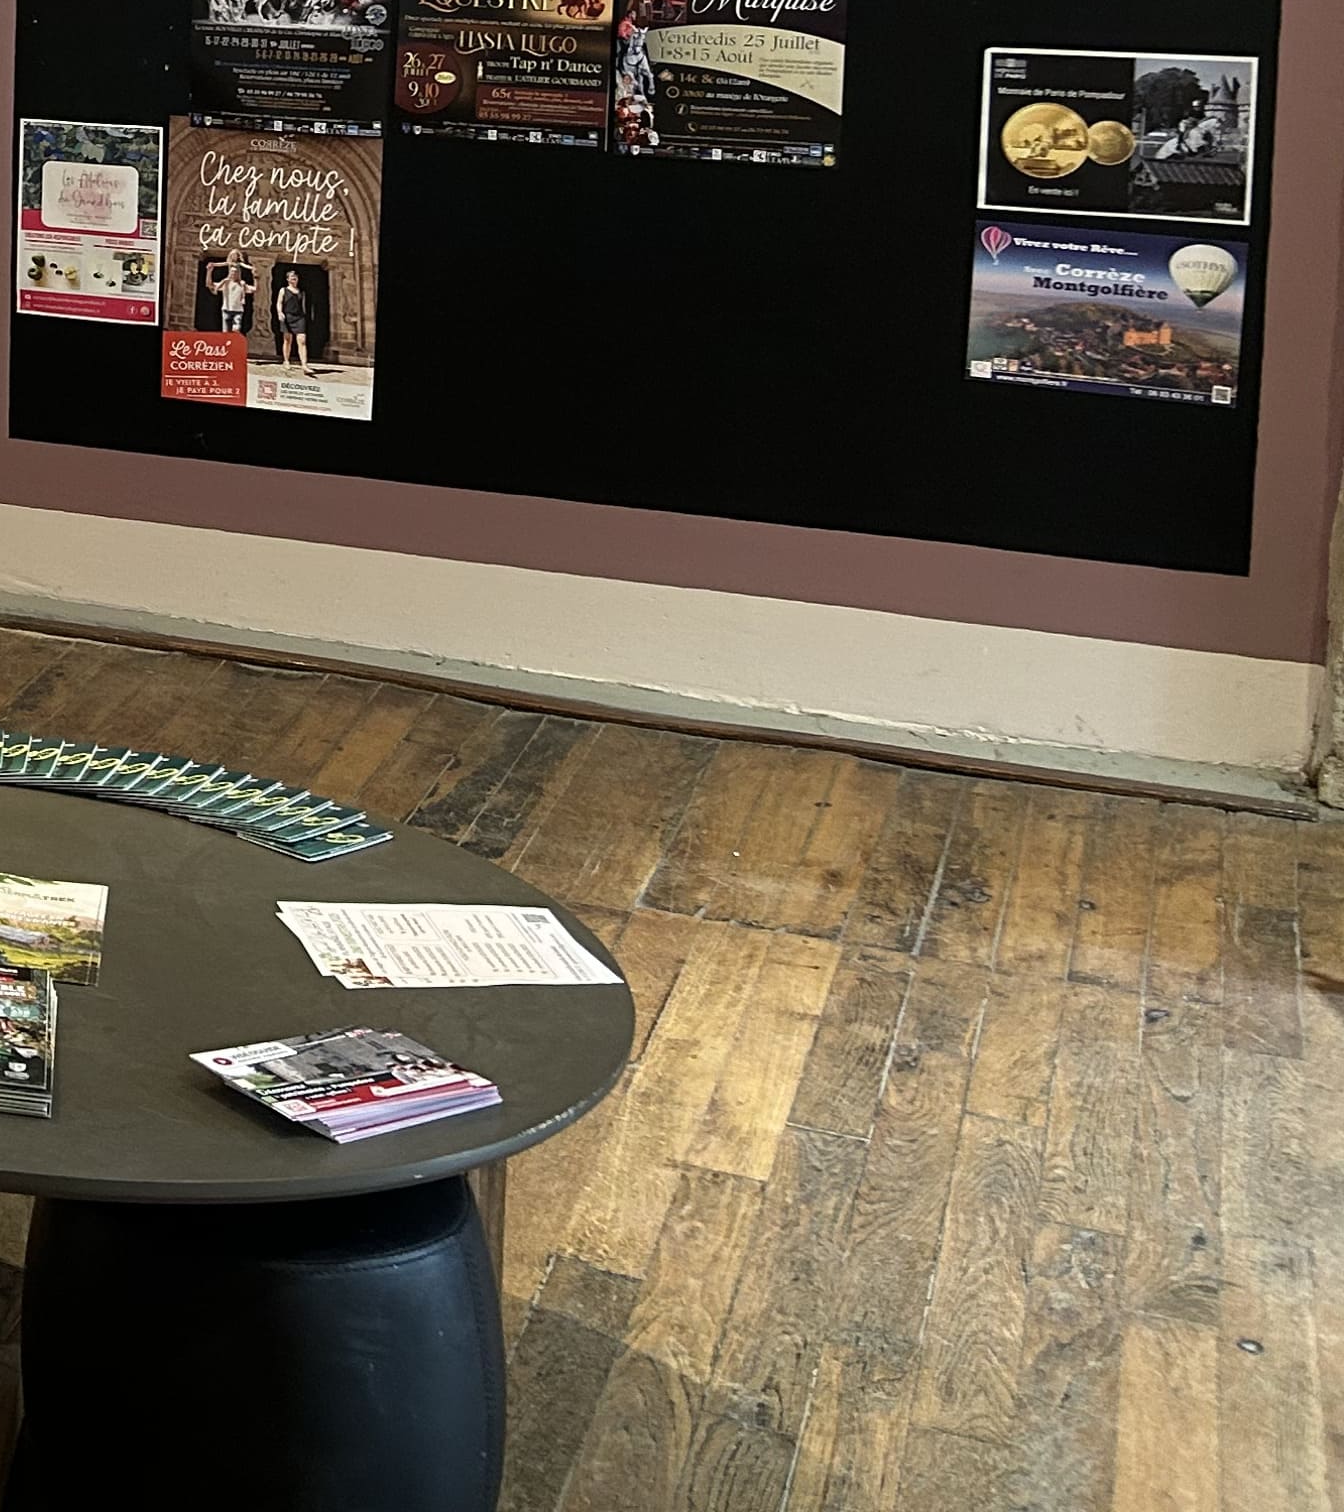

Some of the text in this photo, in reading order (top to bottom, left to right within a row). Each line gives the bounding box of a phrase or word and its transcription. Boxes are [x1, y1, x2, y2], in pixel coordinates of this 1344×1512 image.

[658, 29, 820, 52] Vendredis 25 Juillet
[510, 56, 537, 75] Tap
[540, 58, 554, 71] n'
[556, 58, 602, 74] Dance
[408, 81, 440, 99] 9 10
[200, 150, 351, 199] Chez nous,
[208, 186, 338, 224] la famille
[199, 224, 355, 264] ça compte !
[1055, 263, 1146, 284] Corrèze
[1032, 276, 1169, 301] Montgolfière
[170, 340, 231, 357] Le Pass'
[170, 359, 233, 371] CORRÉZIEN
[209, 387, 232, 395] POUR
